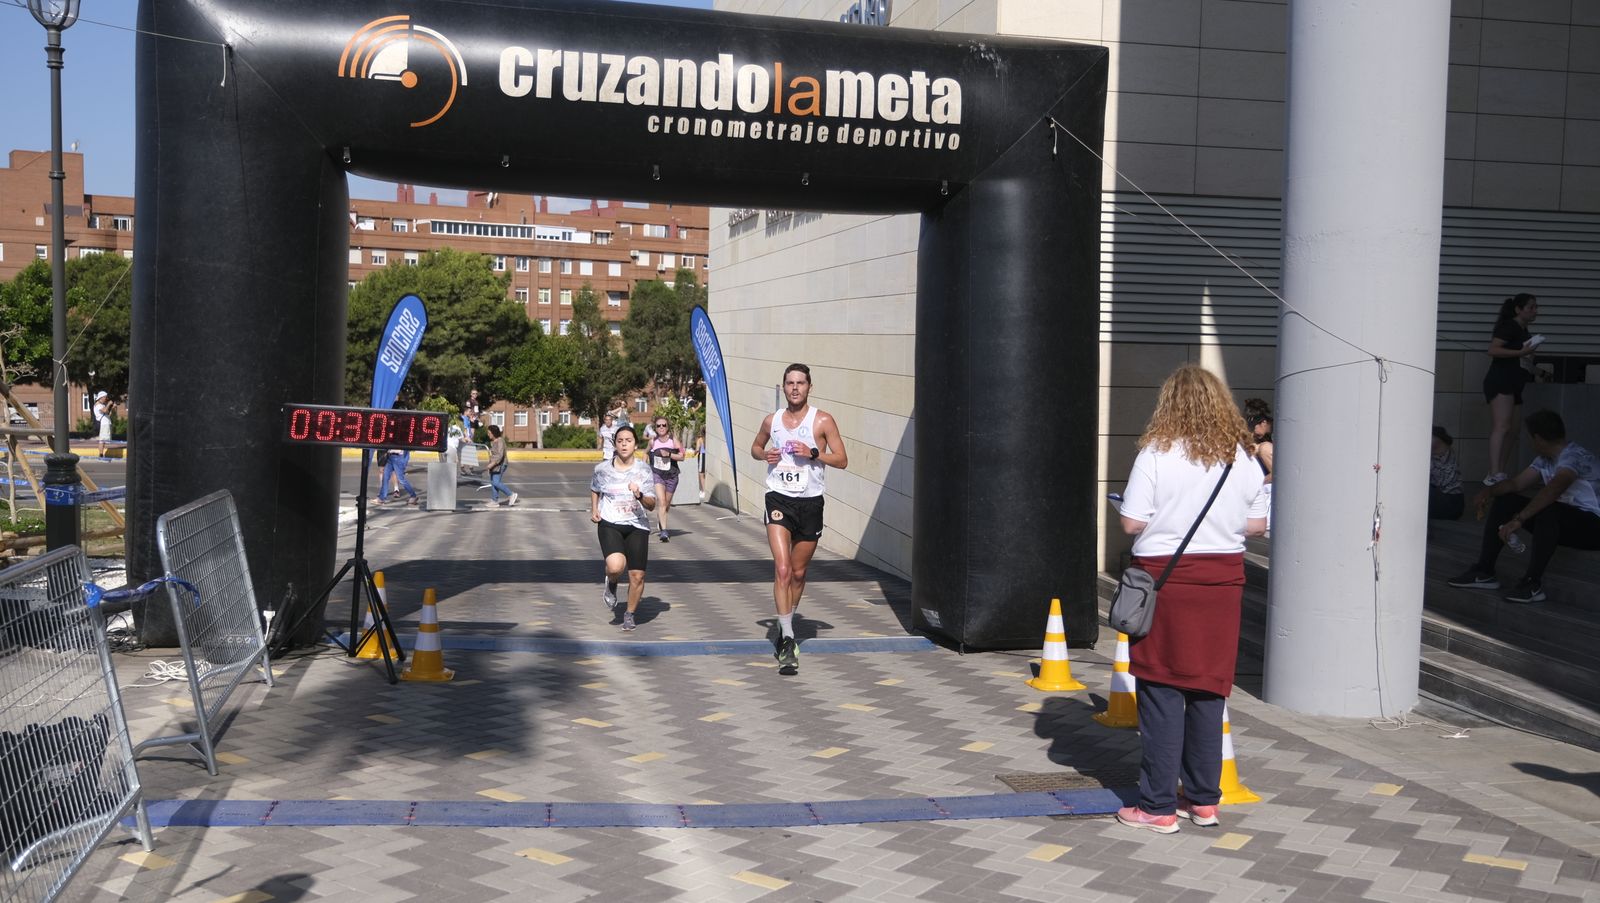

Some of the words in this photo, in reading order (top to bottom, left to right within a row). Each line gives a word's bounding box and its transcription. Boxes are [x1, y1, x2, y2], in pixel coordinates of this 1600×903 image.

[498, 46, 962, 124] cruzandolameta
[647, 115, 829, 145] cronometraje
[836, 123, 960, 151] deportivo
[290, 409, 440, 446] 00:30:19
[779, 472, 800, 482] 161
